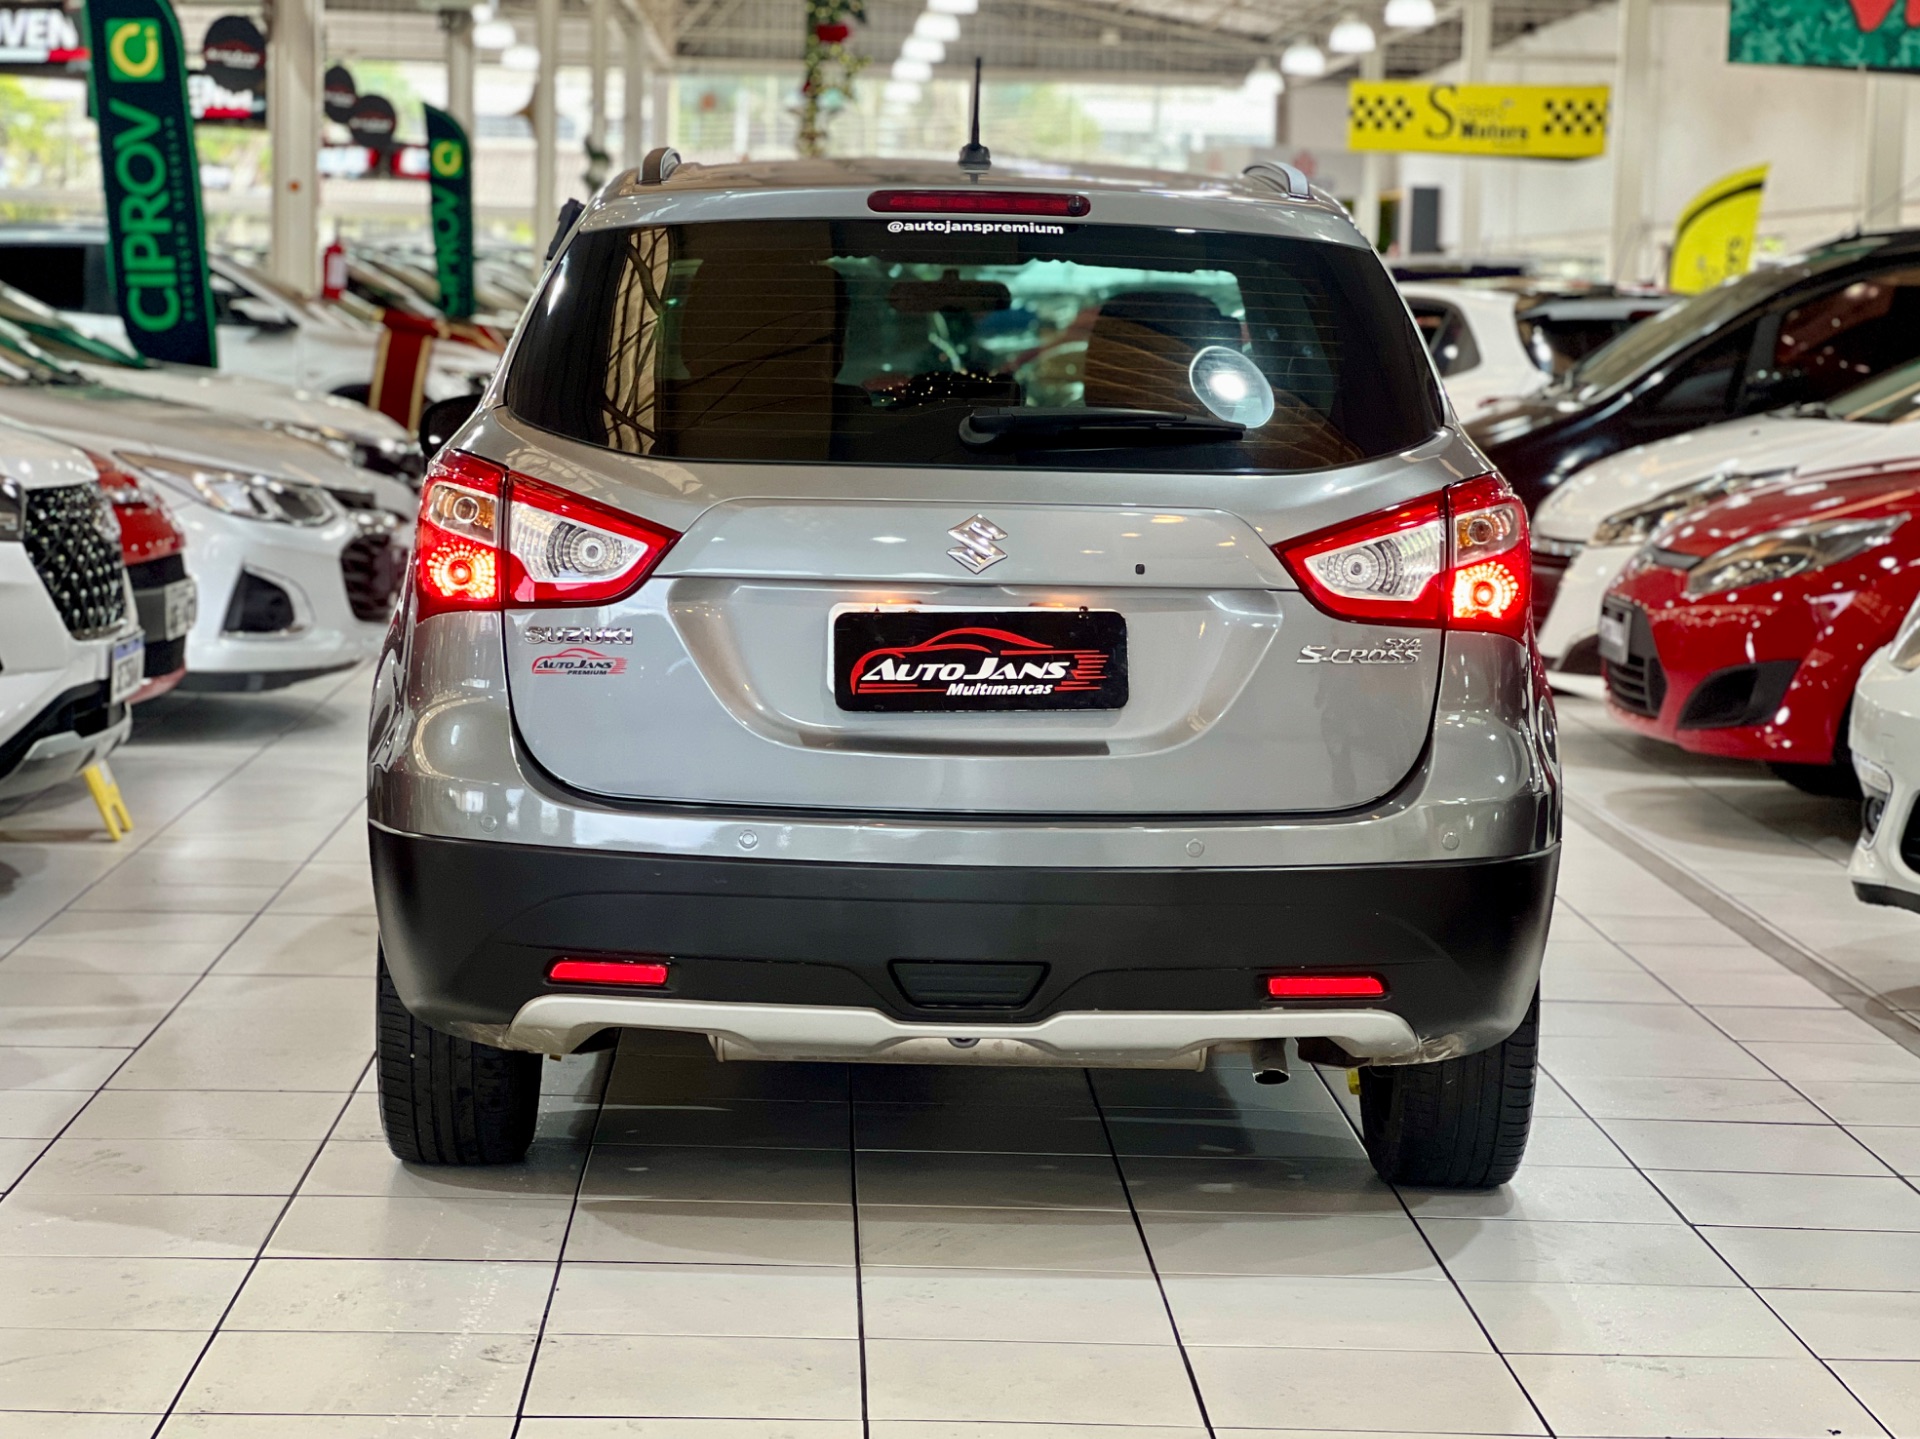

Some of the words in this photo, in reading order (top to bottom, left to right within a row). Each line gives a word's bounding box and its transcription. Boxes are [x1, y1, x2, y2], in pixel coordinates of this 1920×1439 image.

[108, 98, 181, 332] CIPROV
[887, 220, 1064, 235] @autojanspremium
[524, 626, 634, 645] SUZUKI
[1296, 645, 1422, 664] S-CROSS
[946, 682, 1053, 697] Multimarcas
